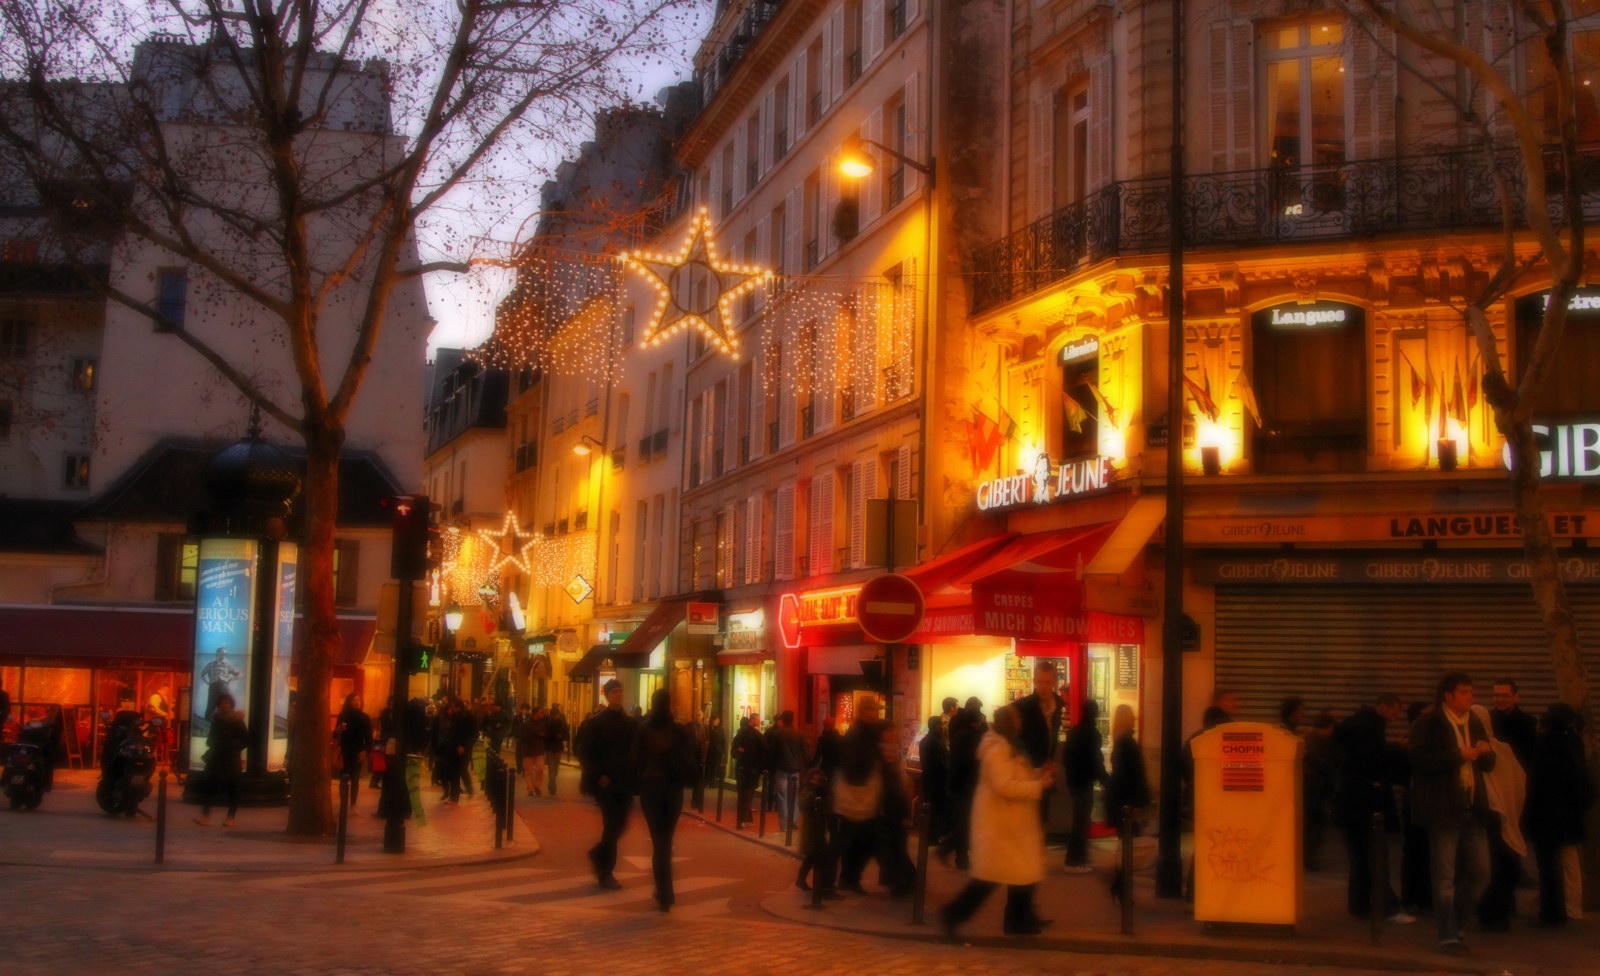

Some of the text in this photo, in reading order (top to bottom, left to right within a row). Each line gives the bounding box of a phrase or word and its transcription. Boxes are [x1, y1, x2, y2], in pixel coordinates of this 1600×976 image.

[1272, 309, 1345, 326] Langues
[977, 457, 1109, 510] GIBERT JEUNE
[1221, 525, 1307, 536] GIBERT JEUNE
[1554, 515, 1587, 534] ET
[1219, 563, 1339, 578] GIBERT JEUNE
[1366, 562, 1491, 578] GIBERT JEUNE
[212, 596, 223, 607] A
[994, 594, 1034, 608] CREPES
[202, 621, 235, 633] MAN
[984, 611, 1136, 638] MICH SANDWICHES
[1222, 745, 1264, 754] CHOPIN
